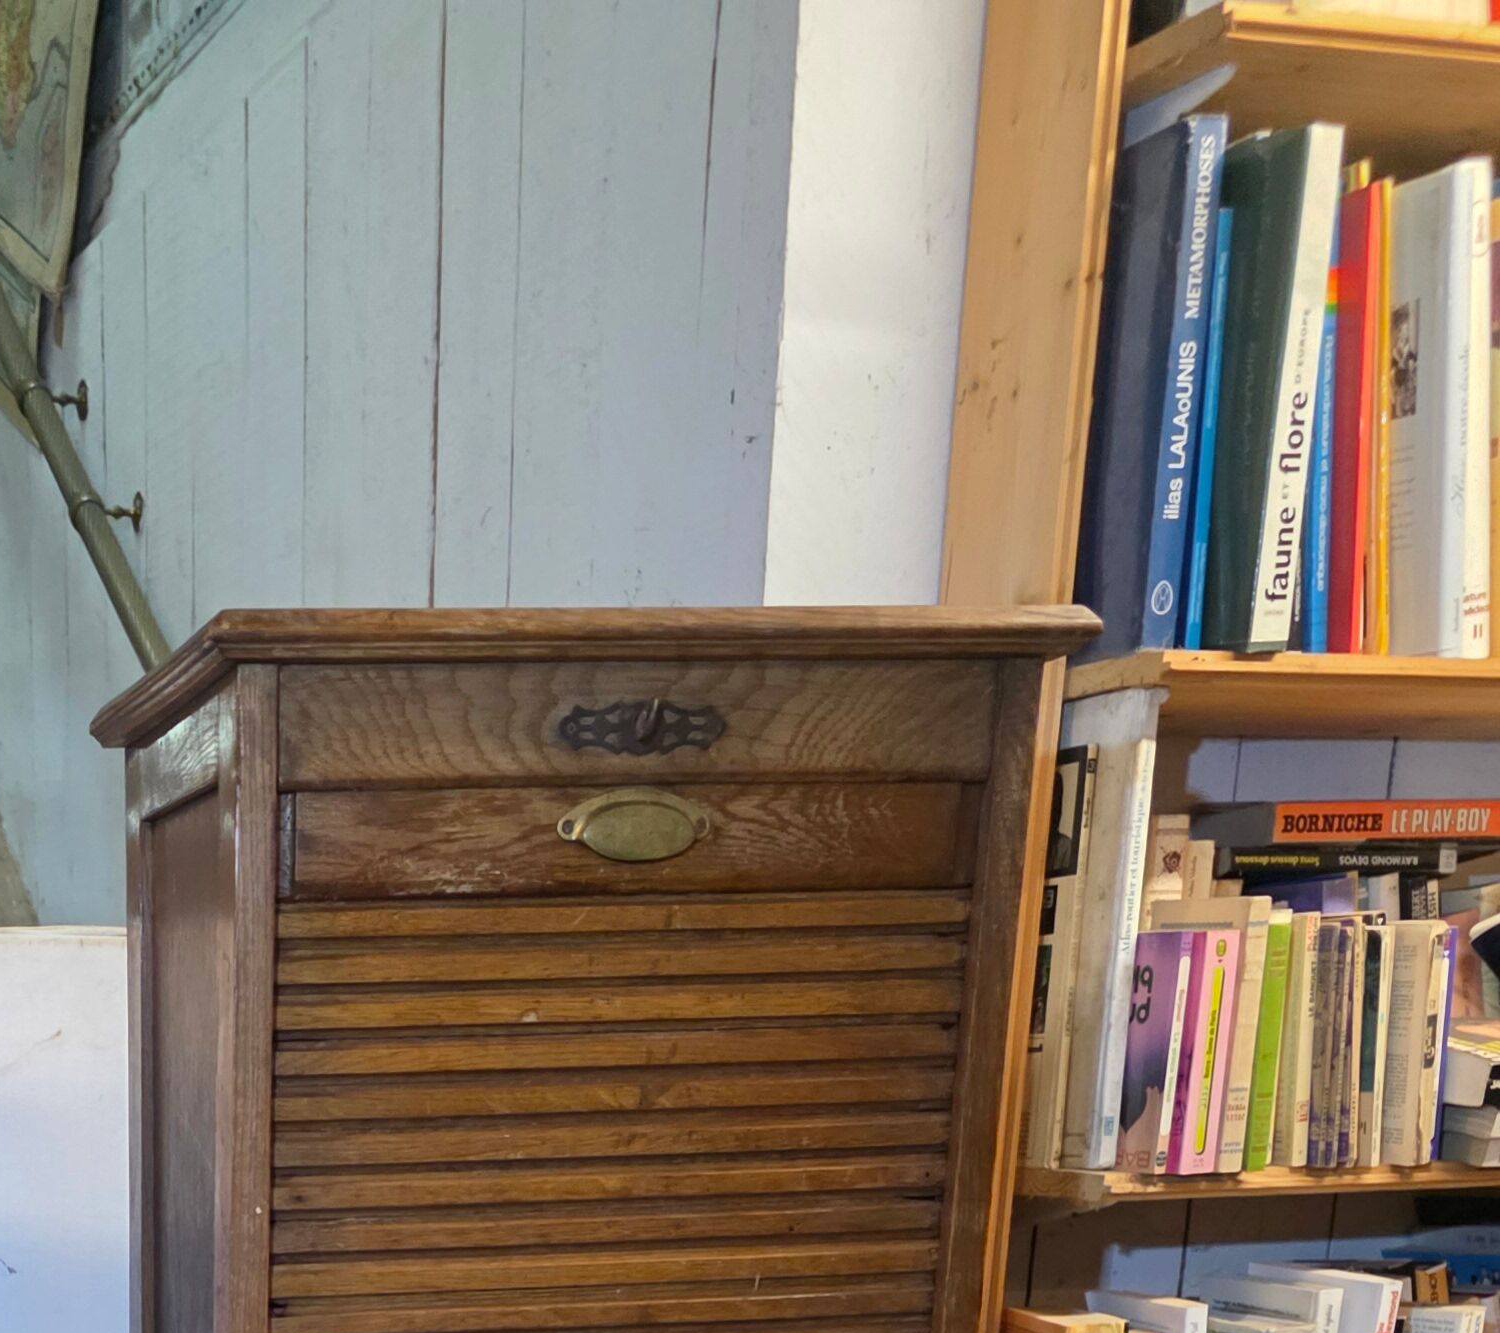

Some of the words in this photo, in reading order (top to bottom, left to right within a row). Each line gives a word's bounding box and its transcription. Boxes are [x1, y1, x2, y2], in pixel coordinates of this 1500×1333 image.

[1184, 135, 1215, 319] METAMORPHOSES
[1168, 341, 1198, 469] LALAoUNIS
[1279, 392, 1308, 473] flore
[1163, 478, 1184, 519] ilias
[1265, 507, 1296, 602] faune
[1281, 812, 1384, 834] BORNICHE
[1390, 809, 1409, 834] LE
[1338, 855, 1370, 867] DEVOS
[1372, 855, 1419, 866] RAYMOND
